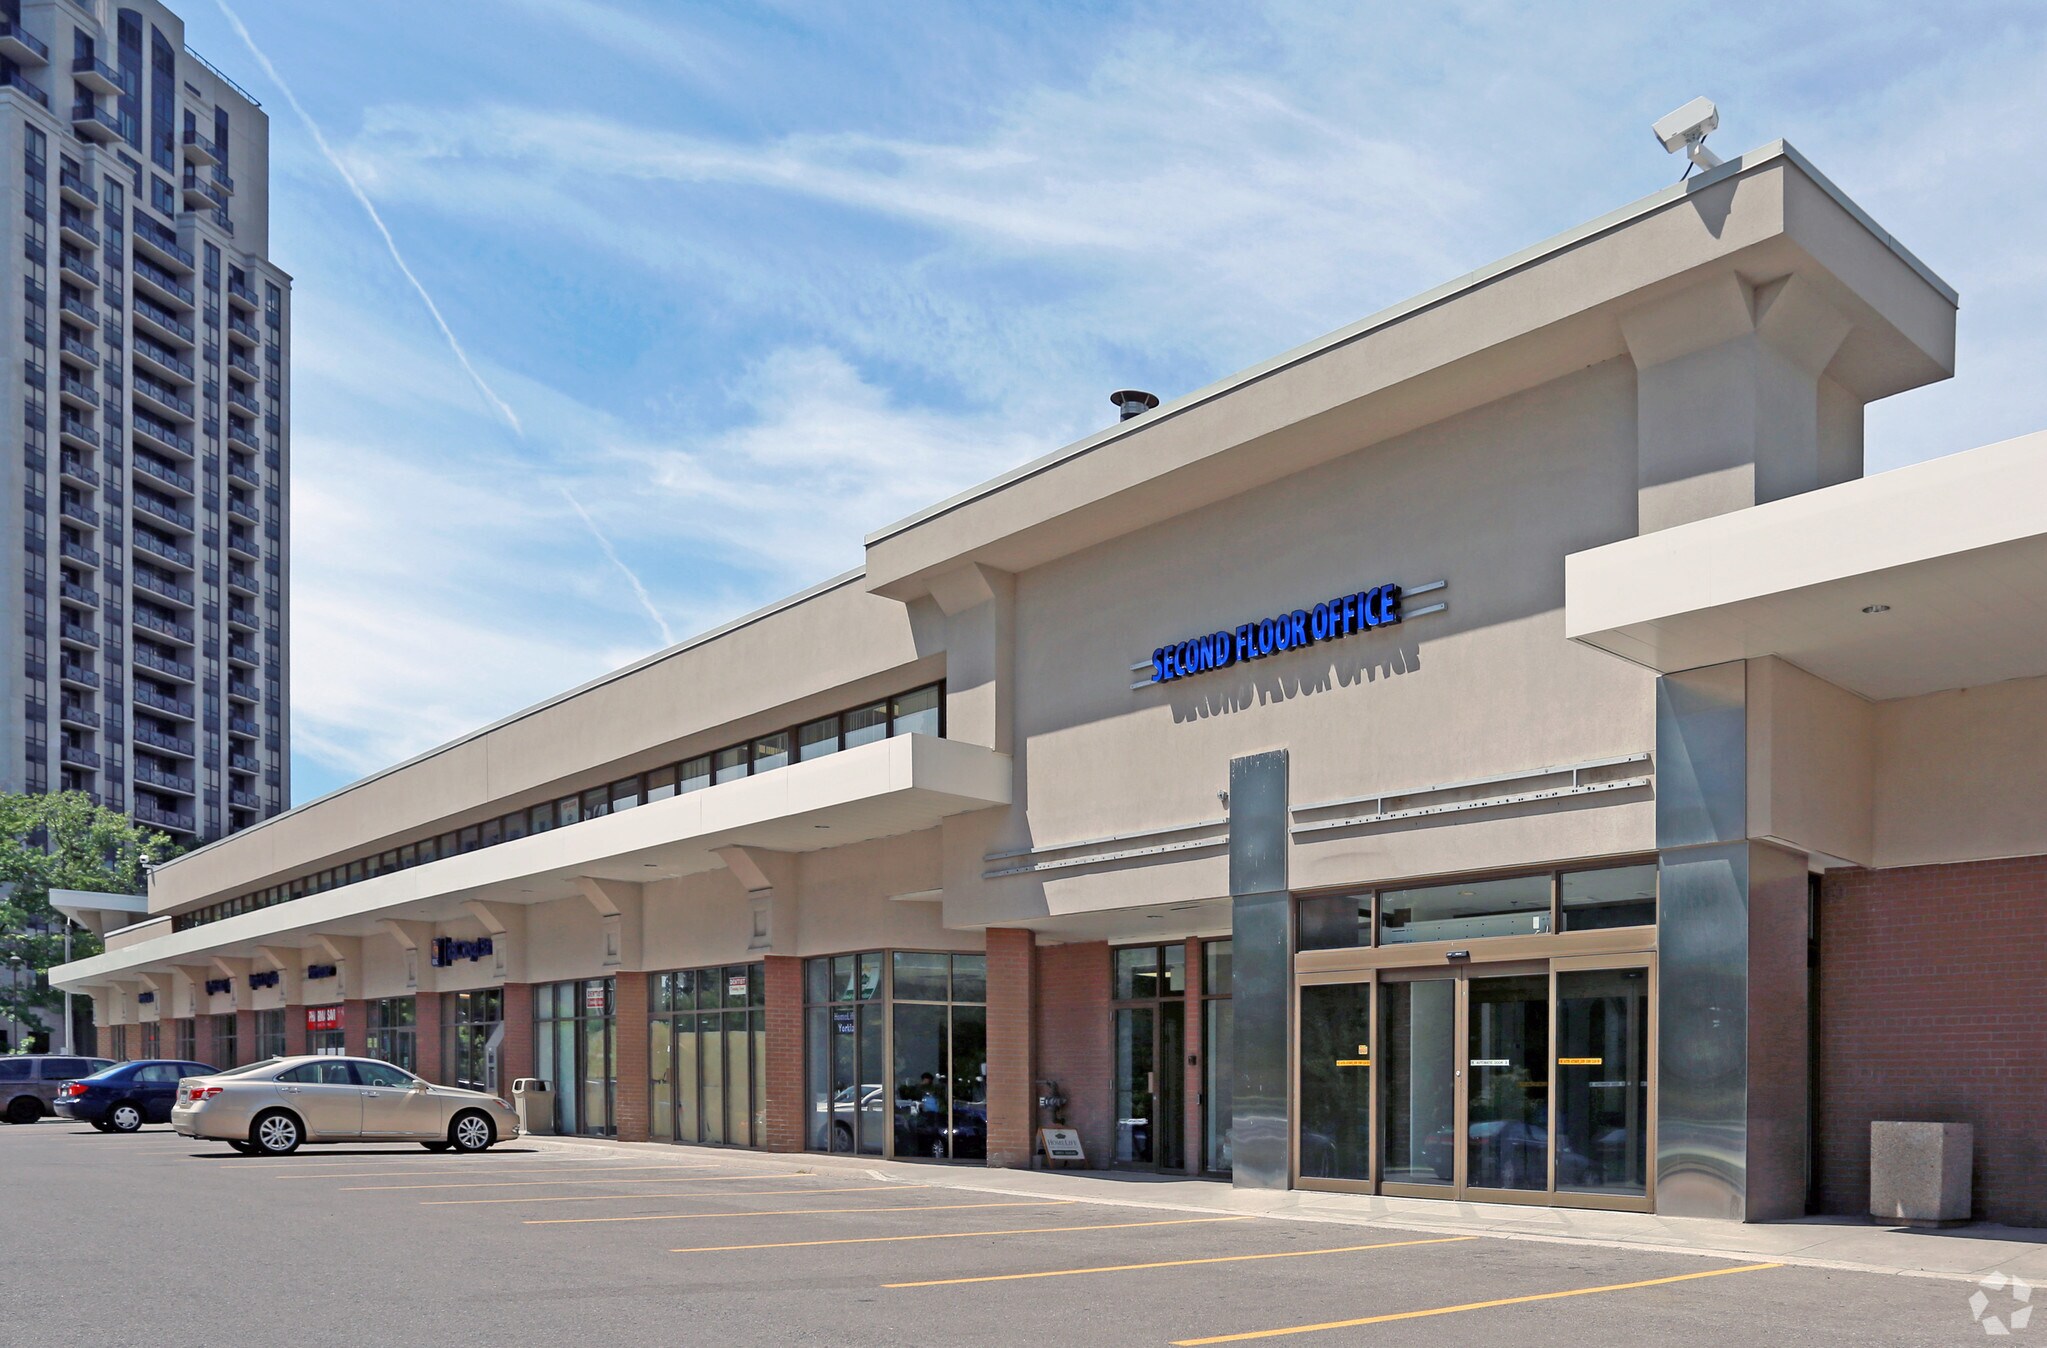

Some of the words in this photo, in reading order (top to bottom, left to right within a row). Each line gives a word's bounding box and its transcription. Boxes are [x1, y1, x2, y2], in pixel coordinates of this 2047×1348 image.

[1152, 631, 1232, 682] SECOND
[1235, 609, 1309, 662] FLOOR
[1311, 583, 1400, 641] OFFICE
